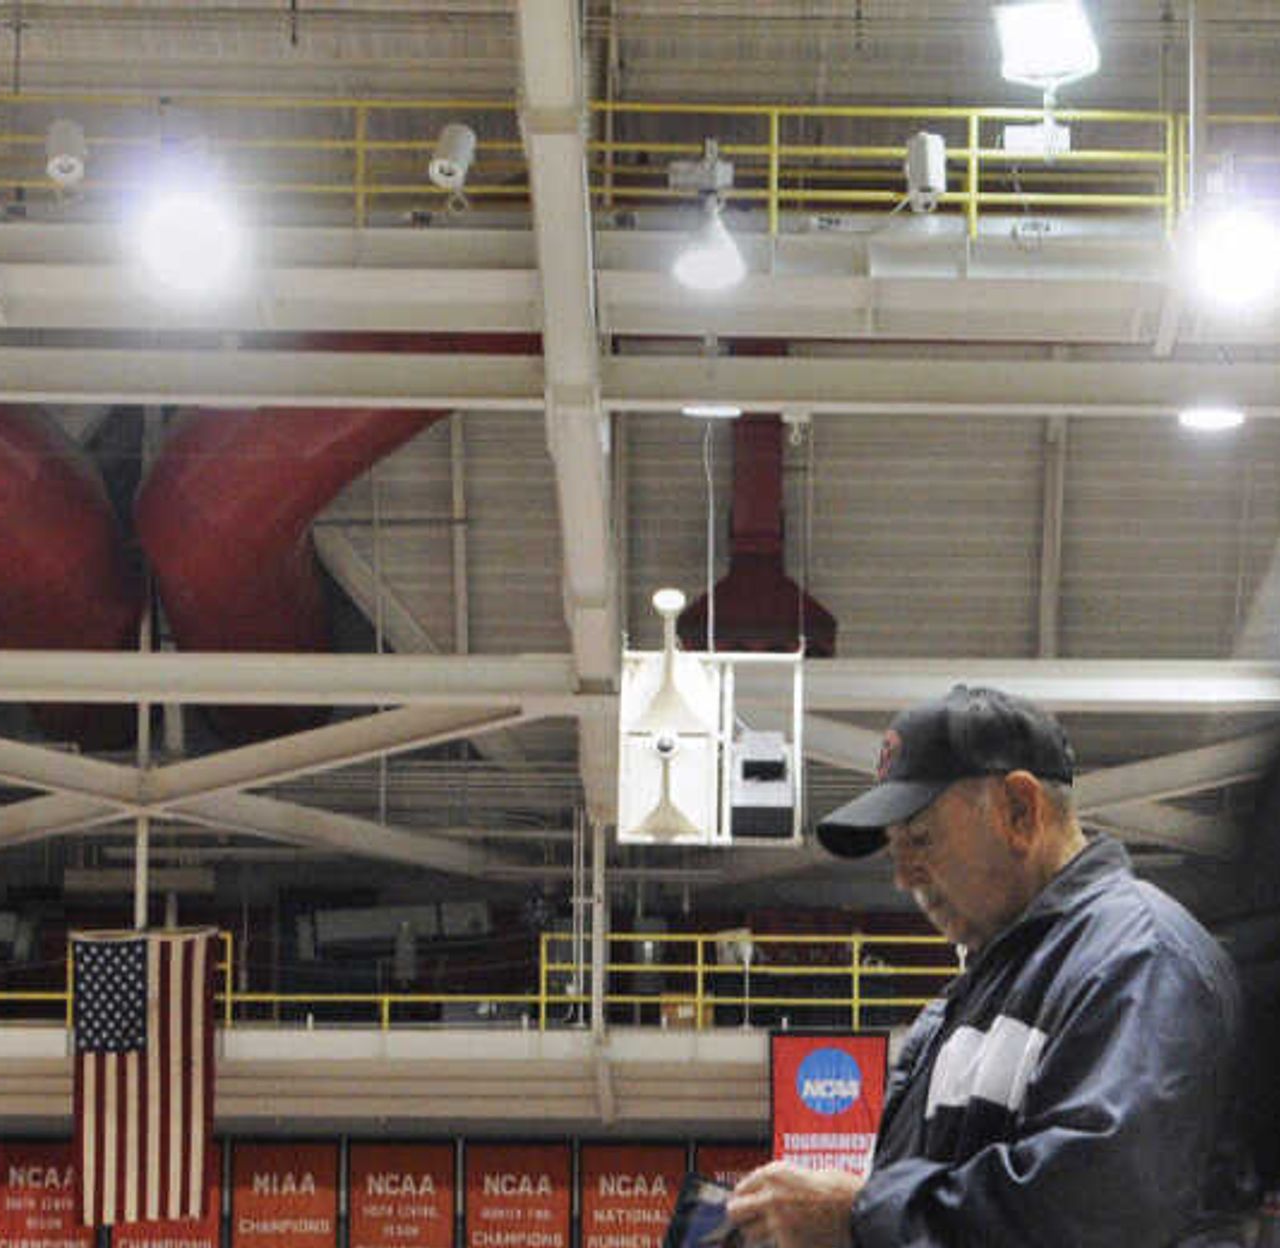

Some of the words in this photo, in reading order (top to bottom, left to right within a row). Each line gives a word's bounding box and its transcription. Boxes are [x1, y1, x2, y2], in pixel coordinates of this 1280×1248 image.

[801, 1080, 859, 1097] NCAA
[252, 1172, 316, 1195] MIAA
[367, 1174, 436, 1195] NCAA
[483, 1174, 553, 1195] NCAA
[598, 1175, 668, 1196] NCAA
[239, 1219, 330, 1234] CHAMPIONS
[471, 1231, 564, 1248] CHAMPIONS
